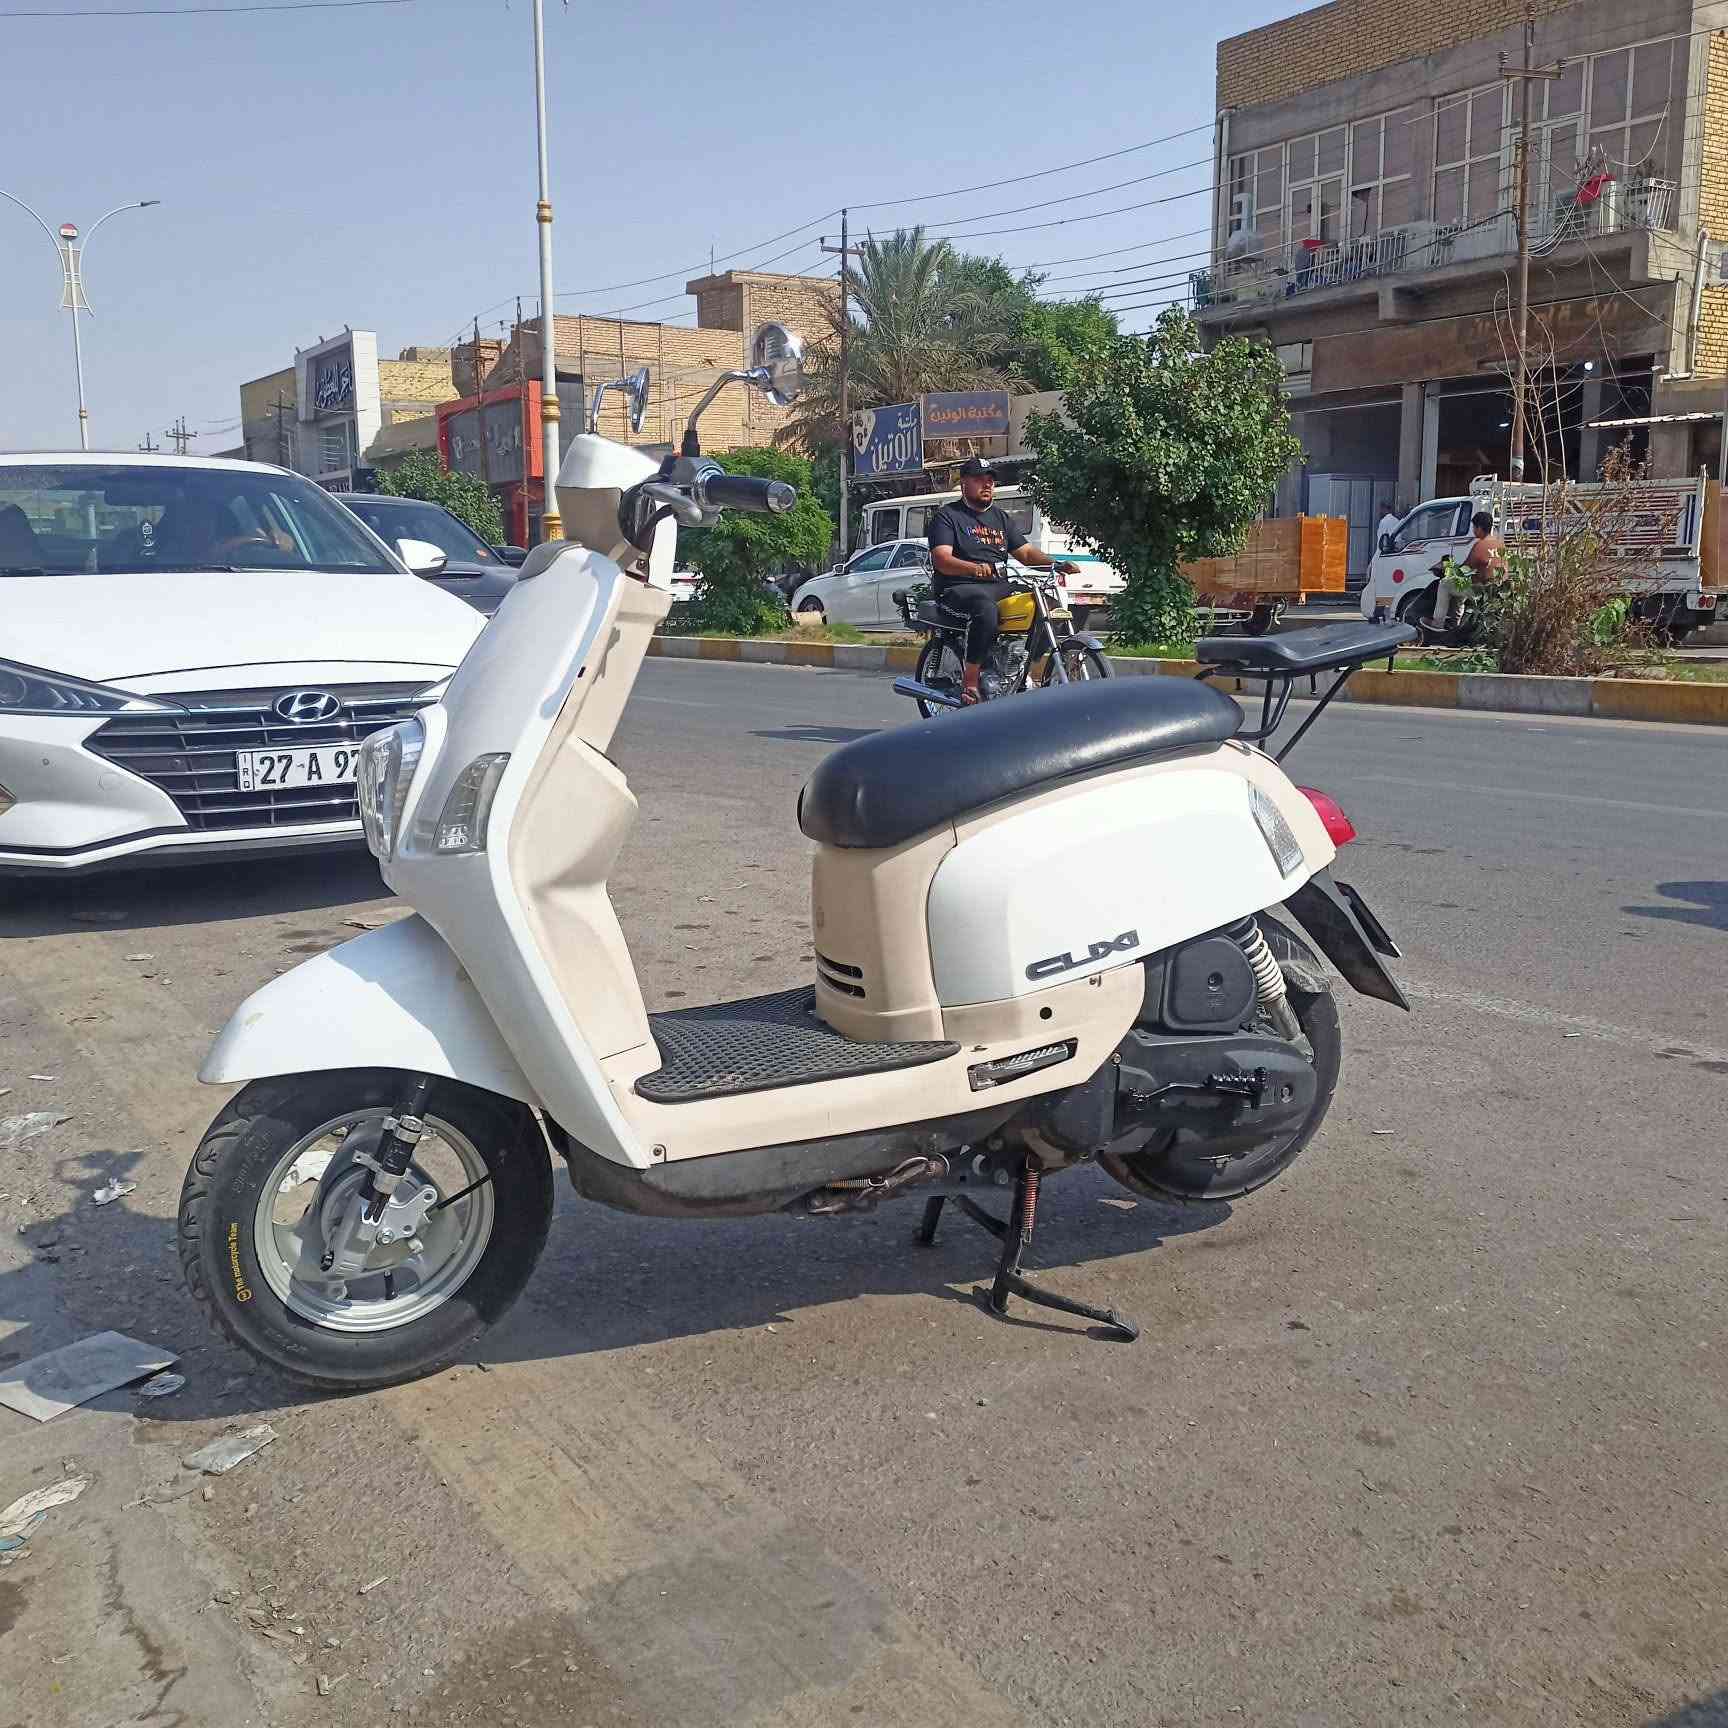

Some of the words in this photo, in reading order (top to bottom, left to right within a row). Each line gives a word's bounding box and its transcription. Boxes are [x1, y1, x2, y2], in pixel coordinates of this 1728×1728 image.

[897, 404, 919, 429] مكتبة
[871, 426, 919, 473] الوتين
[259, 754, 293, 785] 27
[307, 752, 322, 781] A
